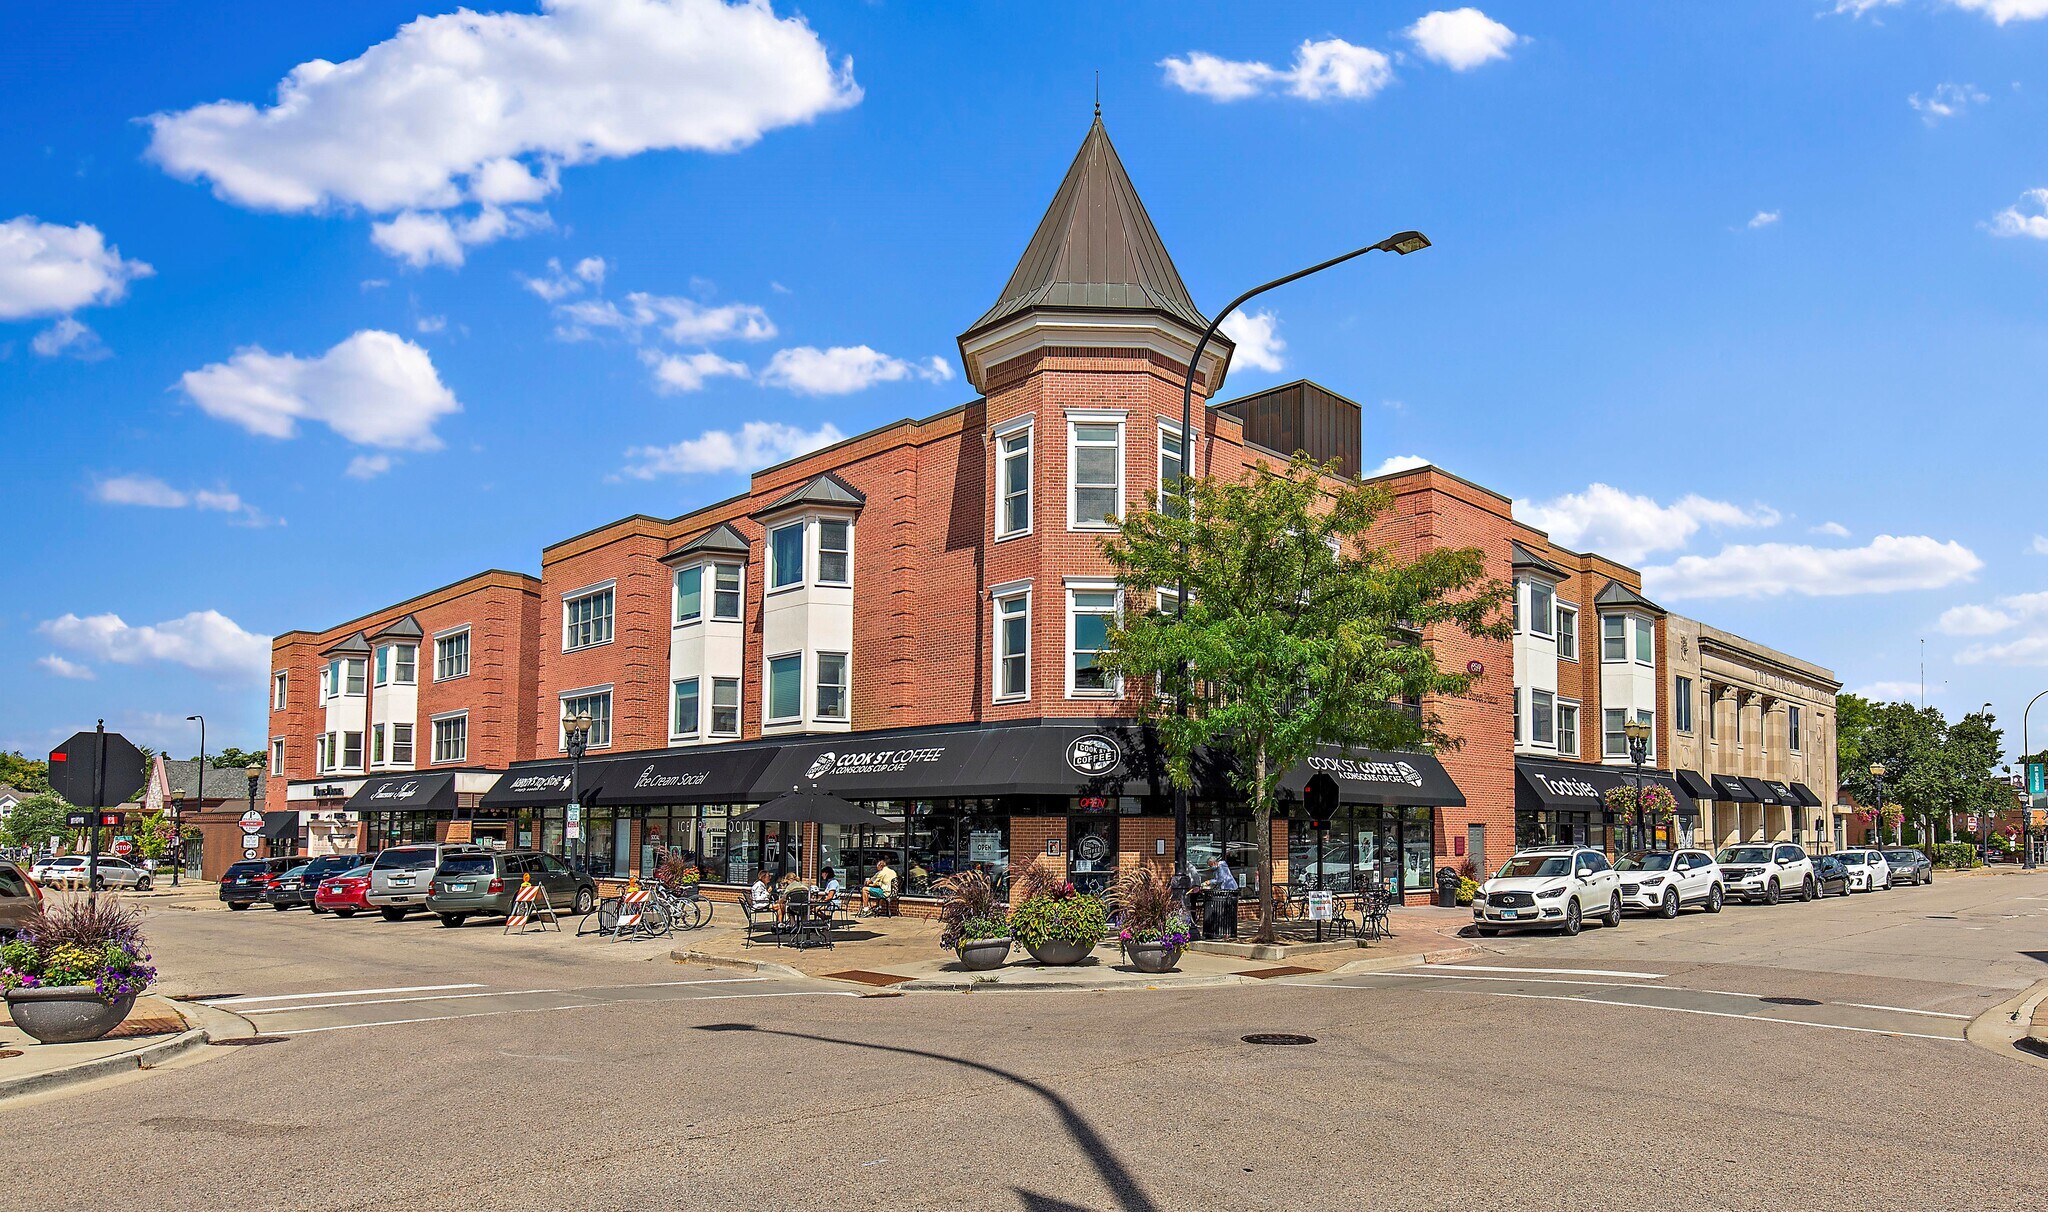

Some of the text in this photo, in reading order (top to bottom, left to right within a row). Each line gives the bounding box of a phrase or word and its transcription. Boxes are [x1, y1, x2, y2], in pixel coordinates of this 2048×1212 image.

[1079, 744, 1098, 753] COOK
[837, 747, 946, 767] COOK ST COFFEE
[1076, 752, 1112, 764] COFFEE
[829, 762, 908, 775] A CONSCIOUS CUP CAFE
[1307, 756, 1400, 776] COOK ST COFFEE
[649, 774, 680, 787] Cream
[677, 770, 711, 786] Social
[1338, 771, 1345, 780] A
[1343, 772, 1379, 782] CONSCIOUS
[1534, 773, 1600, 798] Tootsies
[1080, 798, 1106, 808] OPEN
[677, 820, 756, 833] ICE OCIAL
